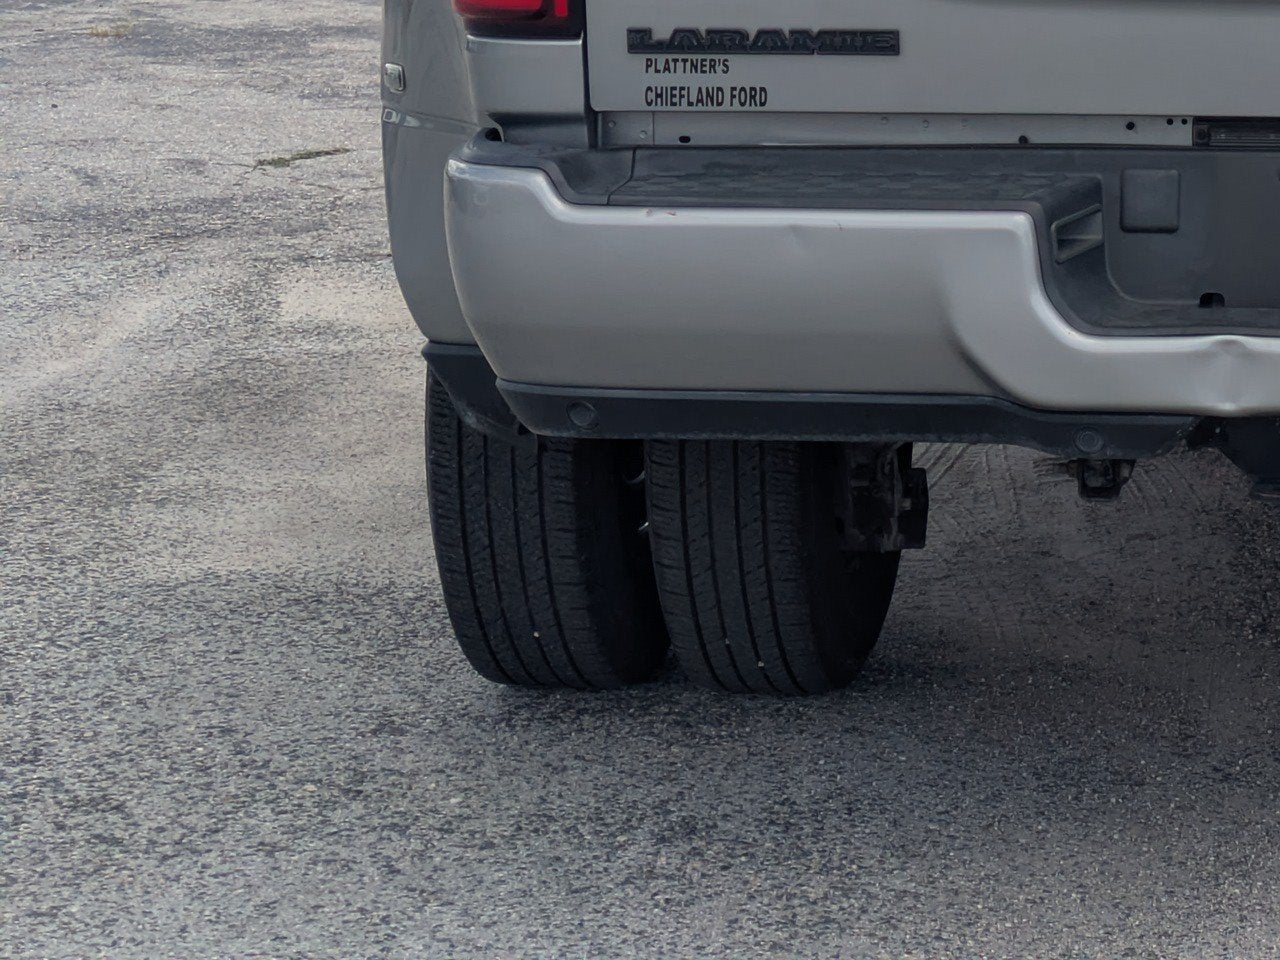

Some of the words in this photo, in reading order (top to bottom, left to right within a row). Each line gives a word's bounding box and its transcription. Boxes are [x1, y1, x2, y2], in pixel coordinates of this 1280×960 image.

[626, 27, 901, 56] LARAMIE
[644, 57, 731, 75] PLATTNER'S
[644, 85, 726, 108] CHIEFLAND
[729, 85, 769, 108] FORD
